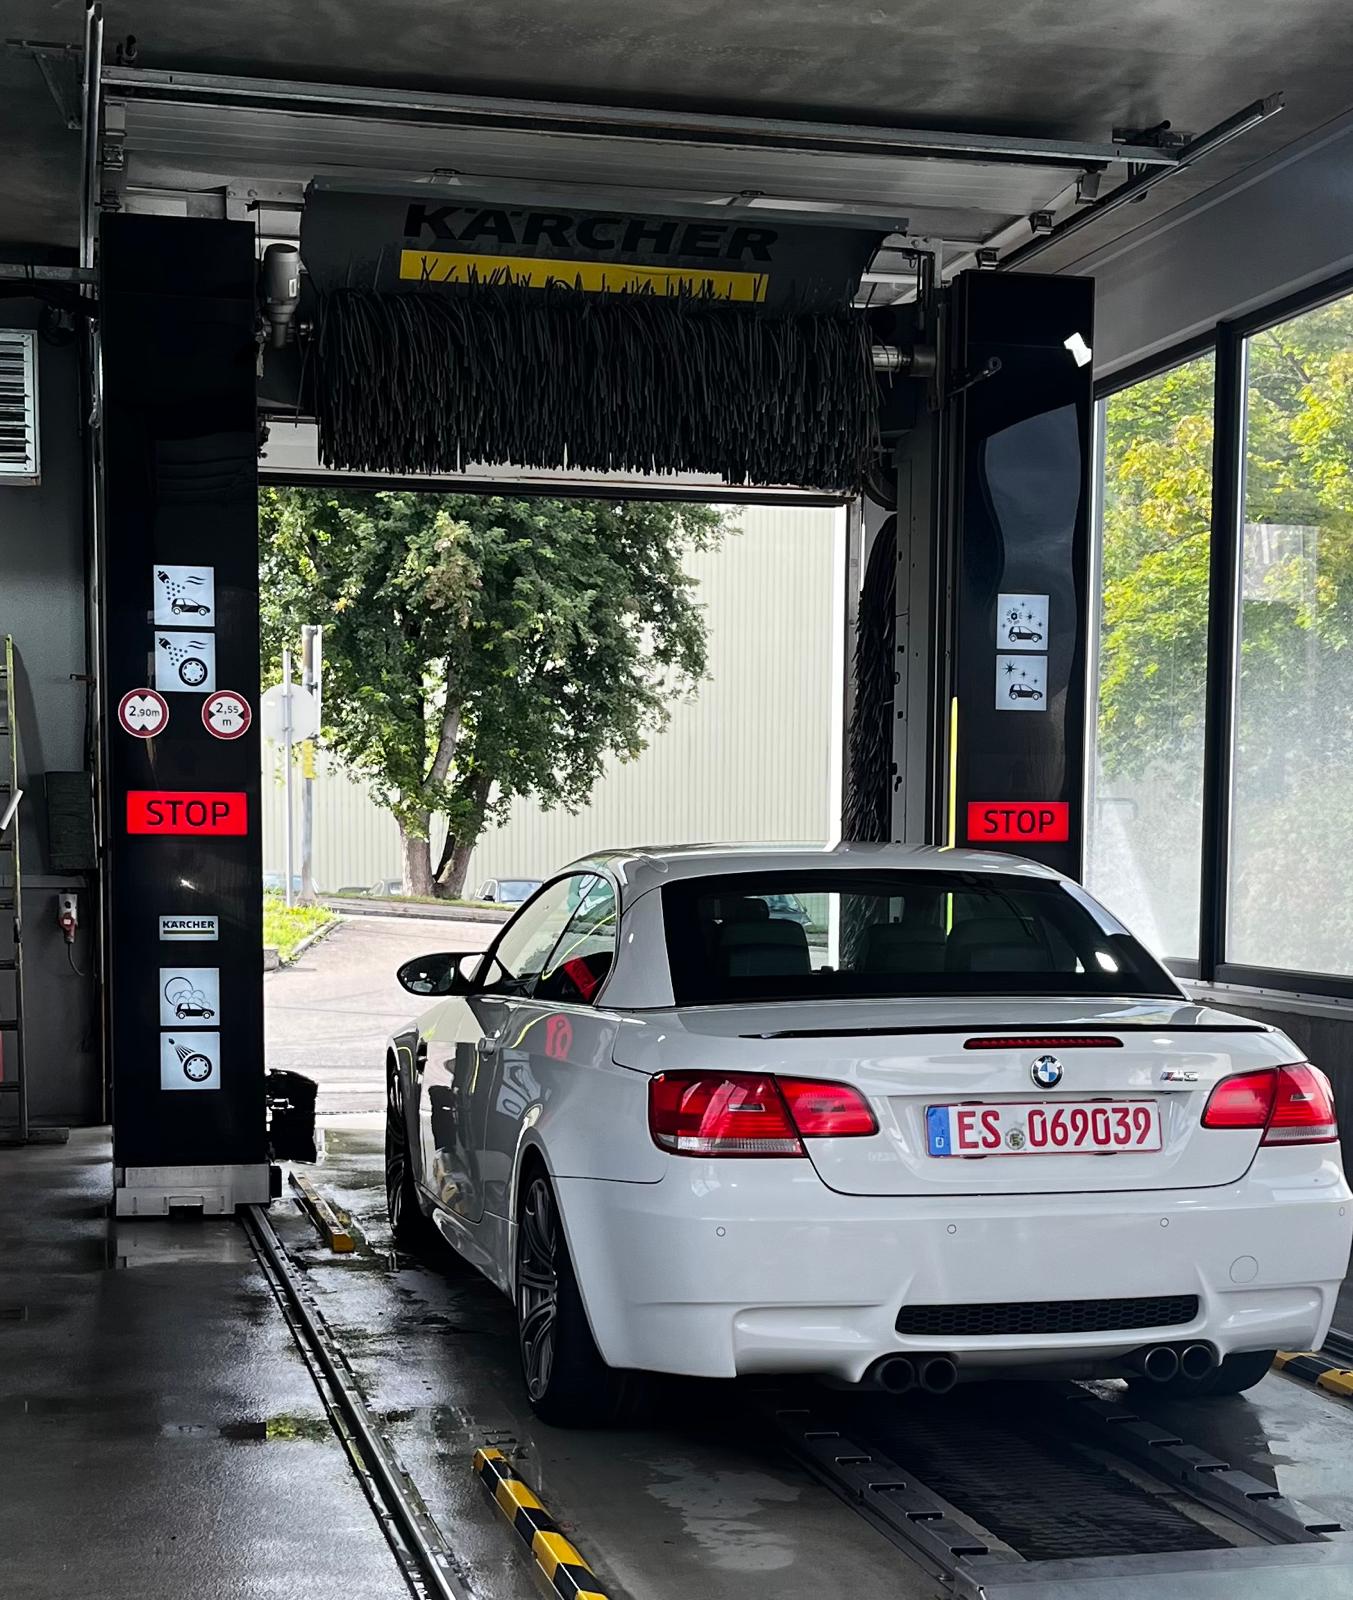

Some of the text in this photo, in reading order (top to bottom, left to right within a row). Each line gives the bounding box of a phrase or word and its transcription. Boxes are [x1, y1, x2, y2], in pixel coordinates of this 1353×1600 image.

[403, 204, 778, 261] KÄRCHER
[216, 703, 239, 714] 2,55
[222, 718, 232, 726] m
[146, 800, 230, 826] STOP
[983, 810, 1055, 833] STOP
[162, 920, 215, 929] KÄRCHER
[957, 1110, 1002, 1149] ES
[1027, 1107, 1152, 1147] 069039
